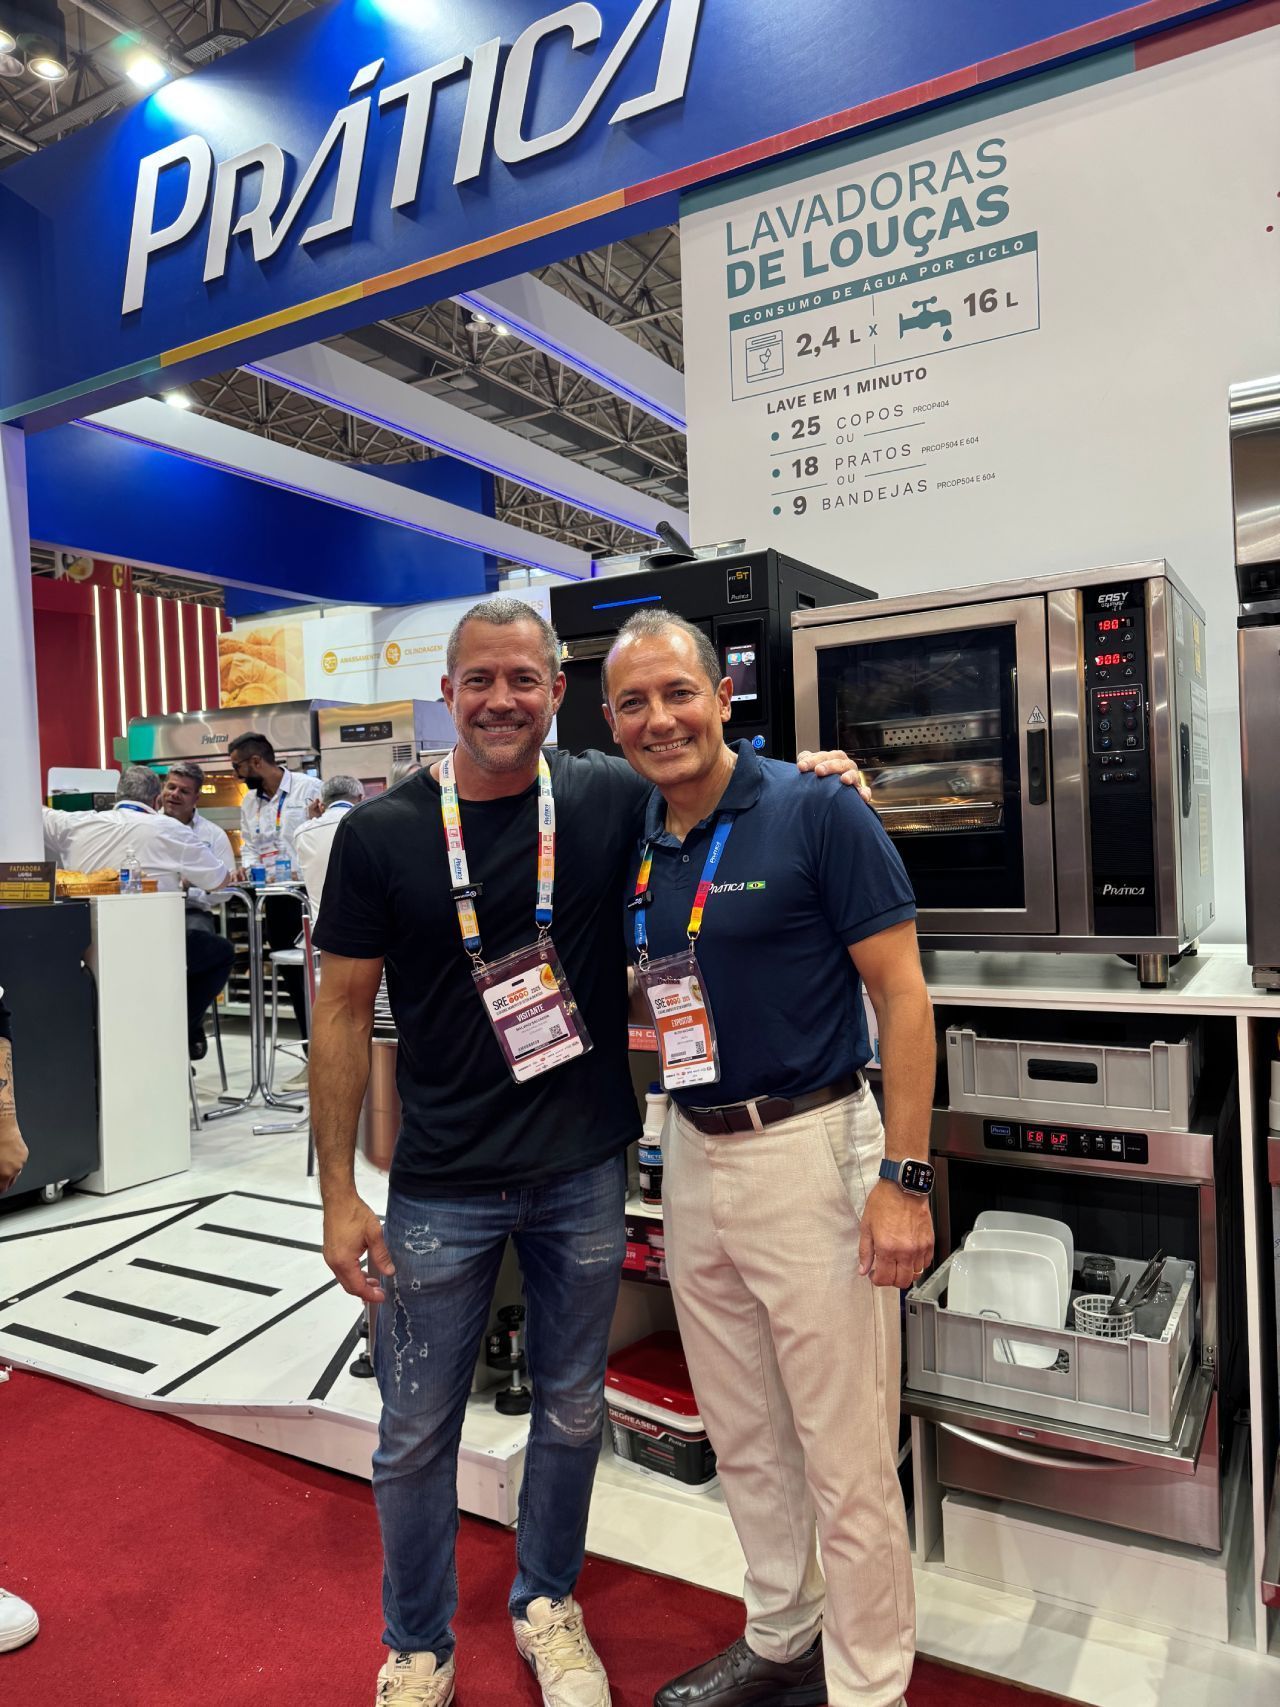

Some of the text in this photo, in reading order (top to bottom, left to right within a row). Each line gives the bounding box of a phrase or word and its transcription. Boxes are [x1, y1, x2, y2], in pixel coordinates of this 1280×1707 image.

[726, 138, 1008, 257] LAVADORAS
[727, 185, 1010, 299] DE LOUÇAS
[743, 240, 1024, 324] CONSUMO DE ÁGUA POR CICLO
[796, 288, 1019, 357] 2,4 L X 16 L
[767, 367, 927, 415] LAVE EM 1 MINUTO
[791, 400, 950, 440] 25 COPOS PRCOP404
[836, 433, 854, 446] OU
[791, 436, 979, 479] 18 PRATOS PRCOP504 E 604
[792, 472, 996, 516] 9 BANDEJAS PRCOP504 E 604
[836, 473, 855, 486] OU
[1098, 591, 1129, 604] EASY
[516, 1003, 546, 1022] VISITANTE
[608, 1408, 658, 1432] DEGREASER
